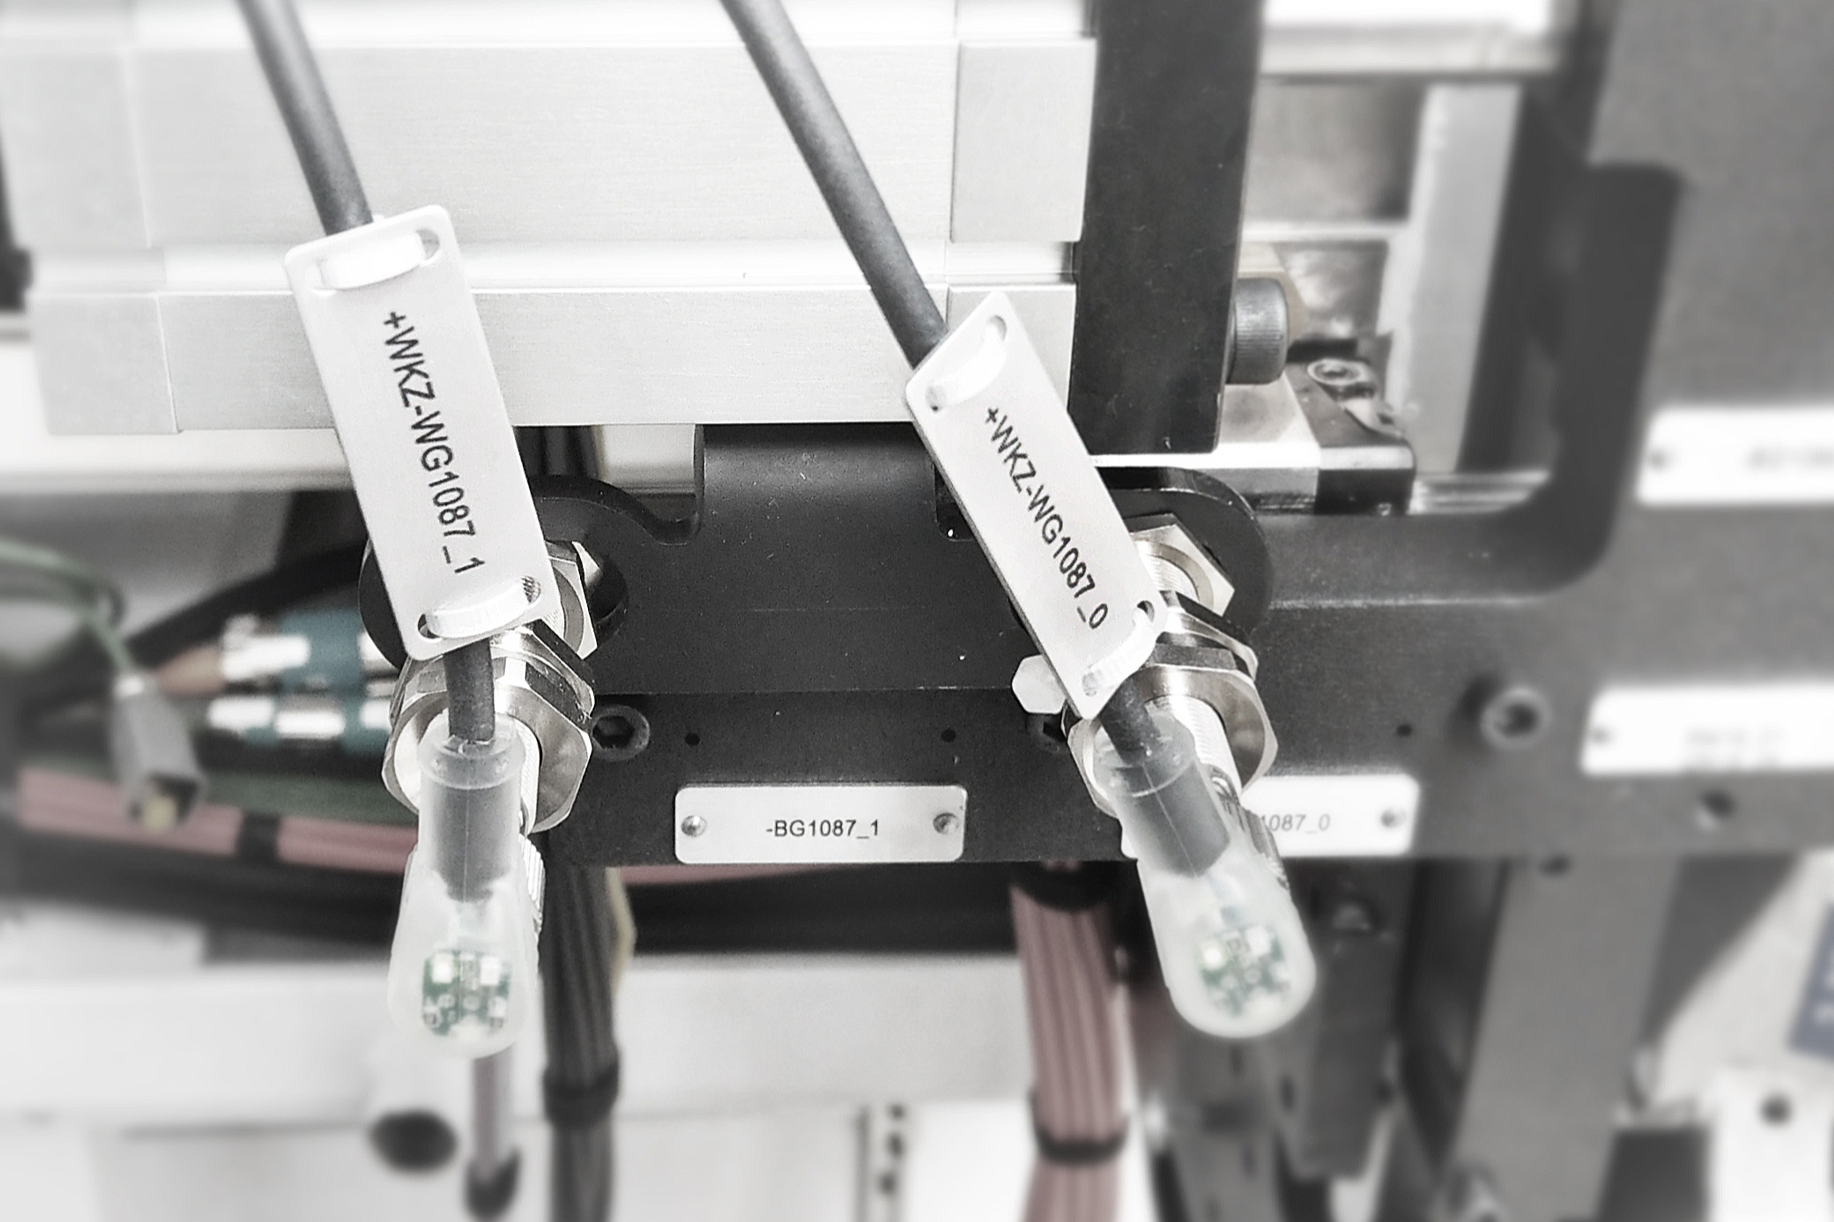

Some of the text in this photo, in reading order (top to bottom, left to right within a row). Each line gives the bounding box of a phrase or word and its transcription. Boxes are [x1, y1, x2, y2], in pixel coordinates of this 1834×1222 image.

[383, 311, 485, 574] +WKZ-WG1087_1
[985, 406, 1109, 630] +WKZ-WG1087_0
[766, 819, 879, 839] -BG1087_1
